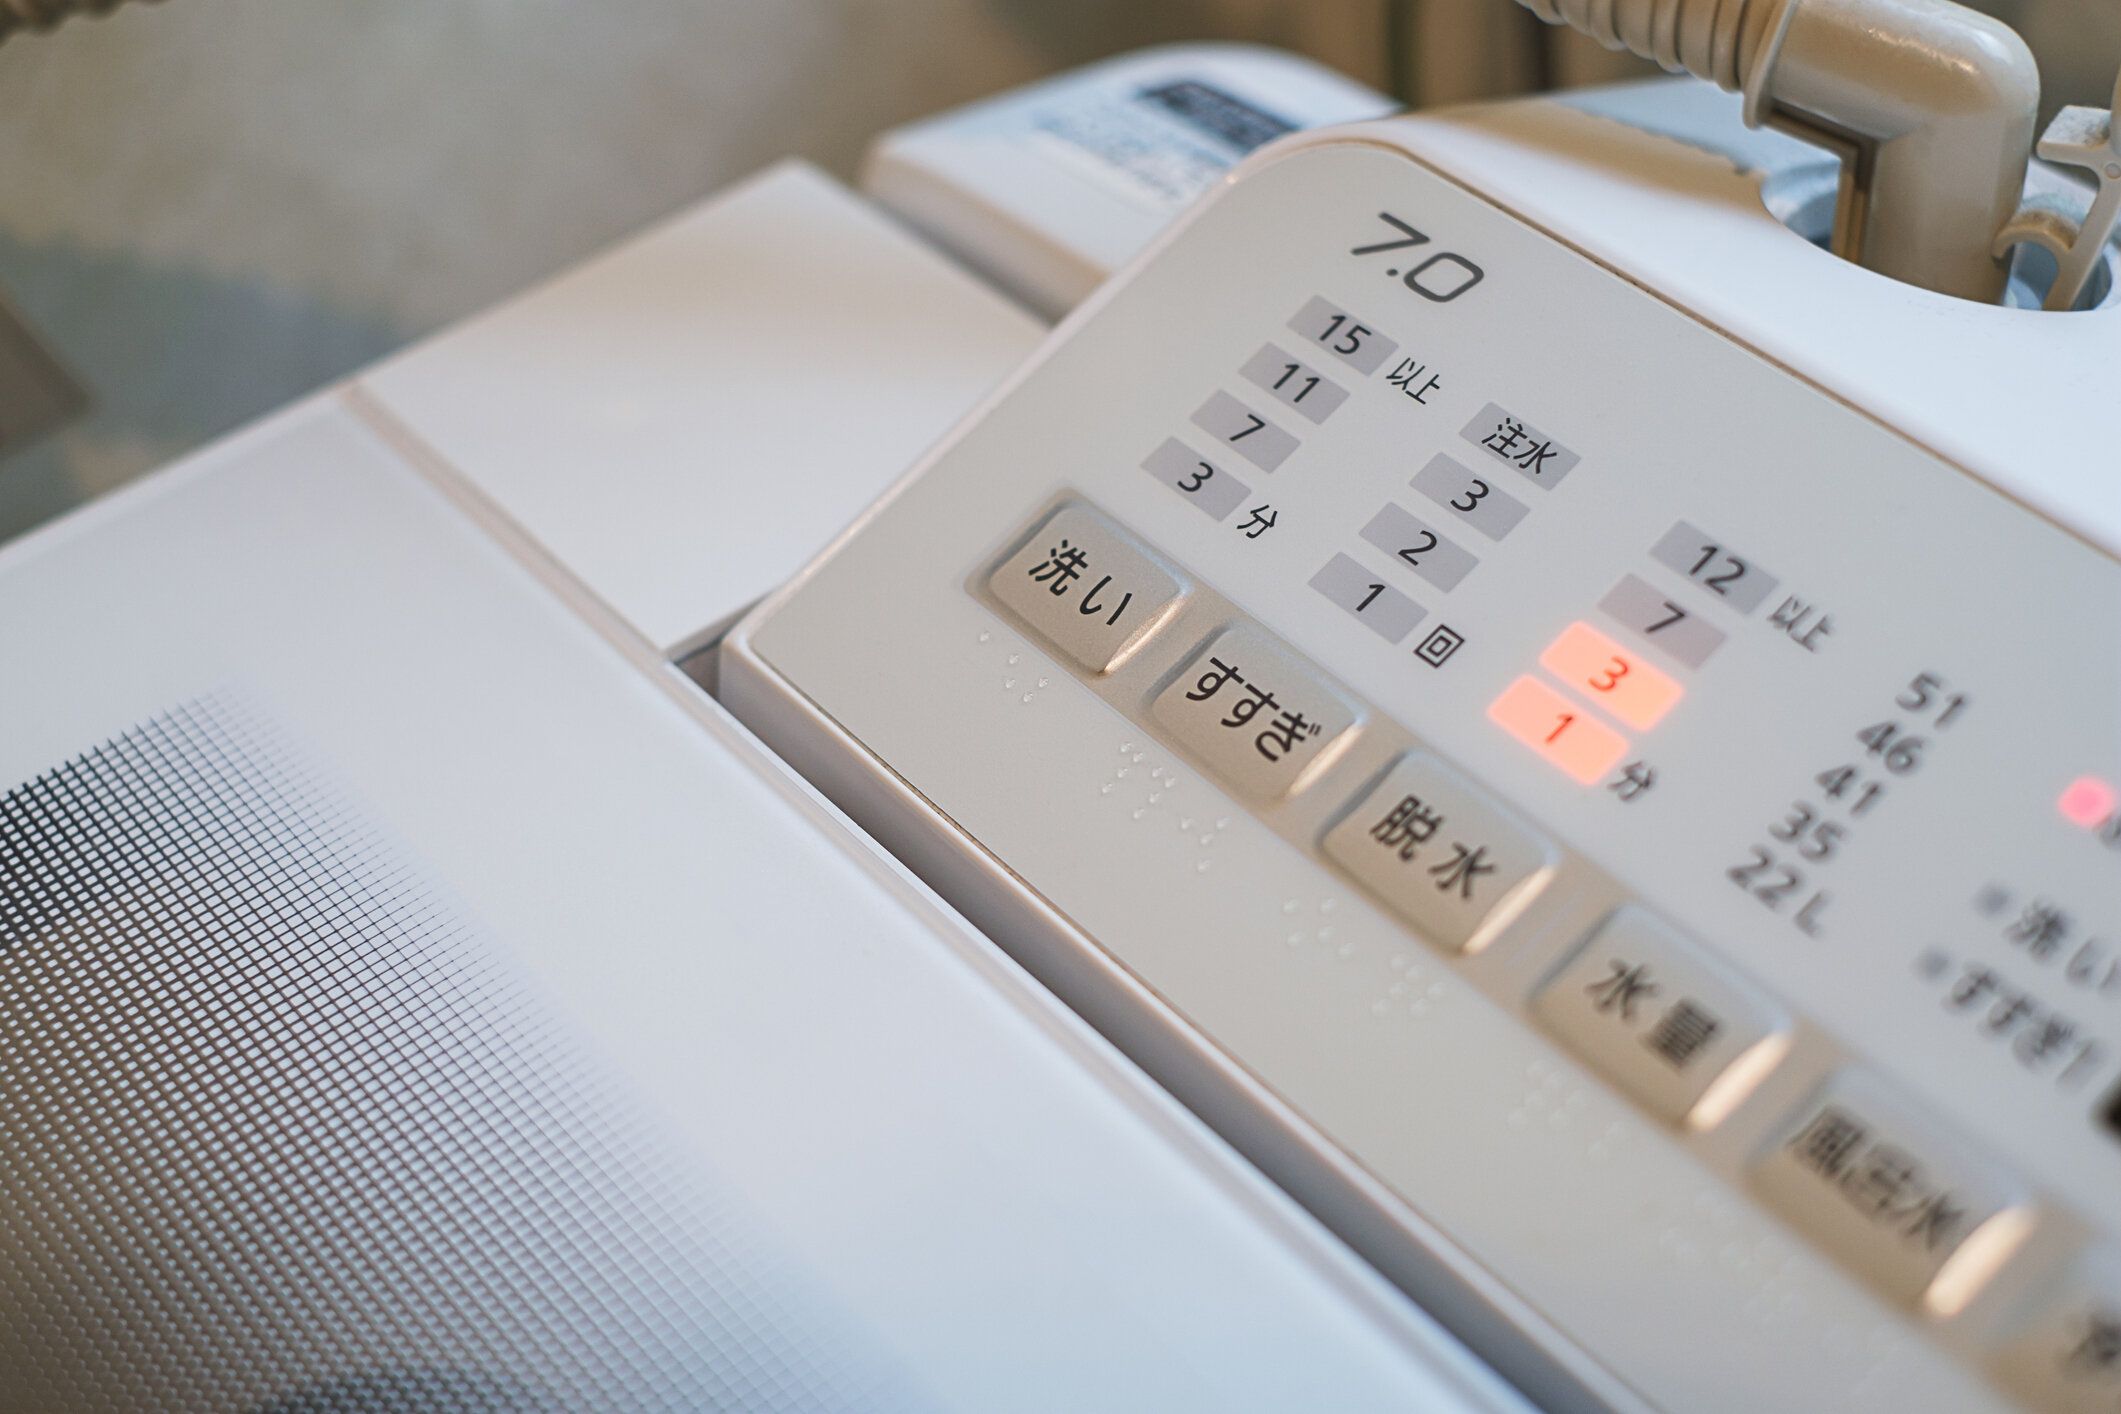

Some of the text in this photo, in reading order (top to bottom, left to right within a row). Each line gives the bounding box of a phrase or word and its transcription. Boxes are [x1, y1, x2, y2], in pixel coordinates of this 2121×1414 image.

[1351, 211, 1484, 302] 7.0
[1273, 362, 1320, 403] 11
[1319, 314, 1441, 405] 15 以上
[1229, 413, 1266, 443] 7
[1481, 417, 1557, 475] 注水
[1177, 461, 1279, 539] 3 分
[1450, 479, 1490, 513] 3
[1398, 530, 1438, 566] 2
[1028, 538, 1133, 626] 洗い
[1688, 545, 1834, 653] 12 以上
[1355, 582, 1466, 669] 1 回
[1644, 600, 1687, 635] 7
[1587, 656, 1630, 693] 3
[1894, 670, 1969, 730] 51
[1185, 656, 1322, 763] すすぎ
[1545, 712, 1657, 802] 1 分
[1855, 720, 1925, 777] 46
[1813, 764, 1884, 818] 41
[1369, 794, 1498, 900] 脱水
[1766, 799, 1847, 864] 35
[1724, 845, 1803, 910] 22
[1583, 957, 1721, 1072] 水量
